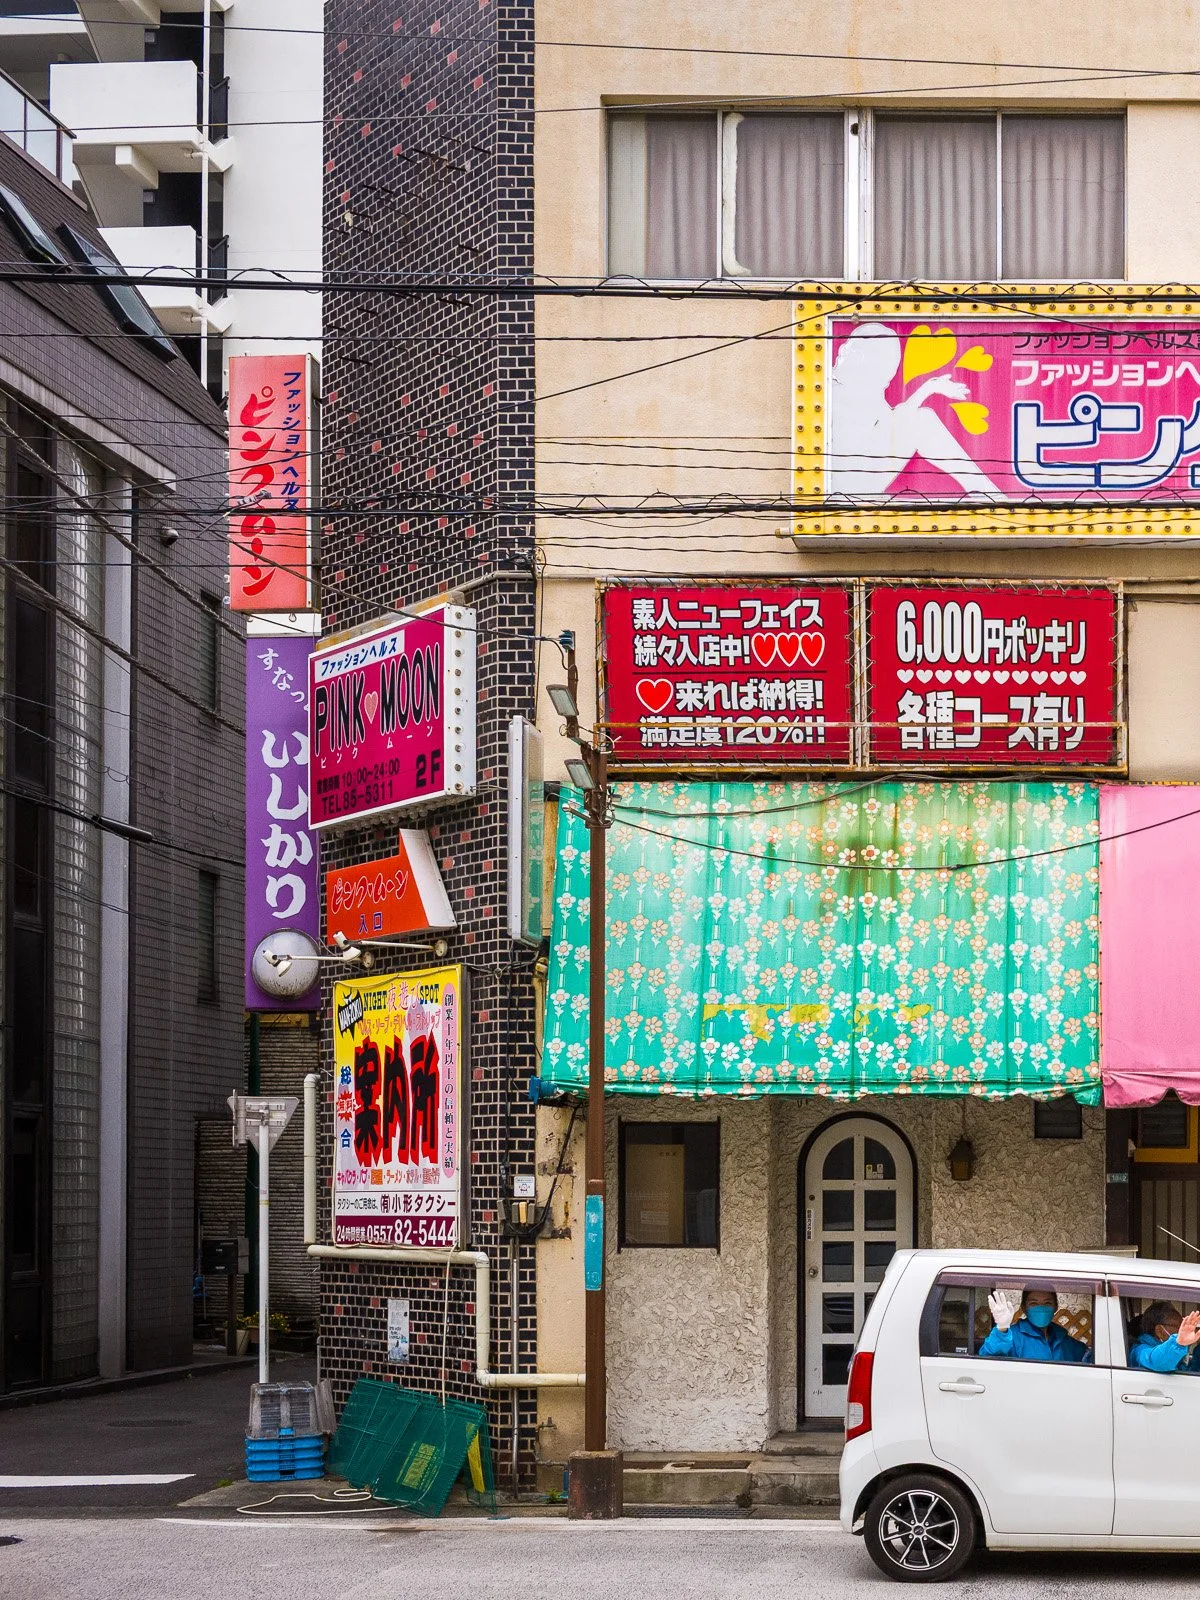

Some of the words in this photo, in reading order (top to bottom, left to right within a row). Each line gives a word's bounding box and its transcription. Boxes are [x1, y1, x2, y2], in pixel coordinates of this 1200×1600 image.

[632, 598, 824, 630] 素人ニューフェイス
[896, 600, 1087, 665] 6,000円ポッキリ
[321, 637, 397, 677] ファッションヘルス
[633, 634, 750, 666] 続々入店中!
[315, 671, 366, 757] PINK
[380, 642, 440, 736] MOON
[675, 679, 824, 711] 来れば納得!
[896, 689, 1086, 750] 各種コース有り
[261, 729, 313, 918] いしかり
[359, 911, 383, 934] 入口
[354, 1034, 439, 1167] 案内所
[394, 1219, 457, 1245] 82-5444
